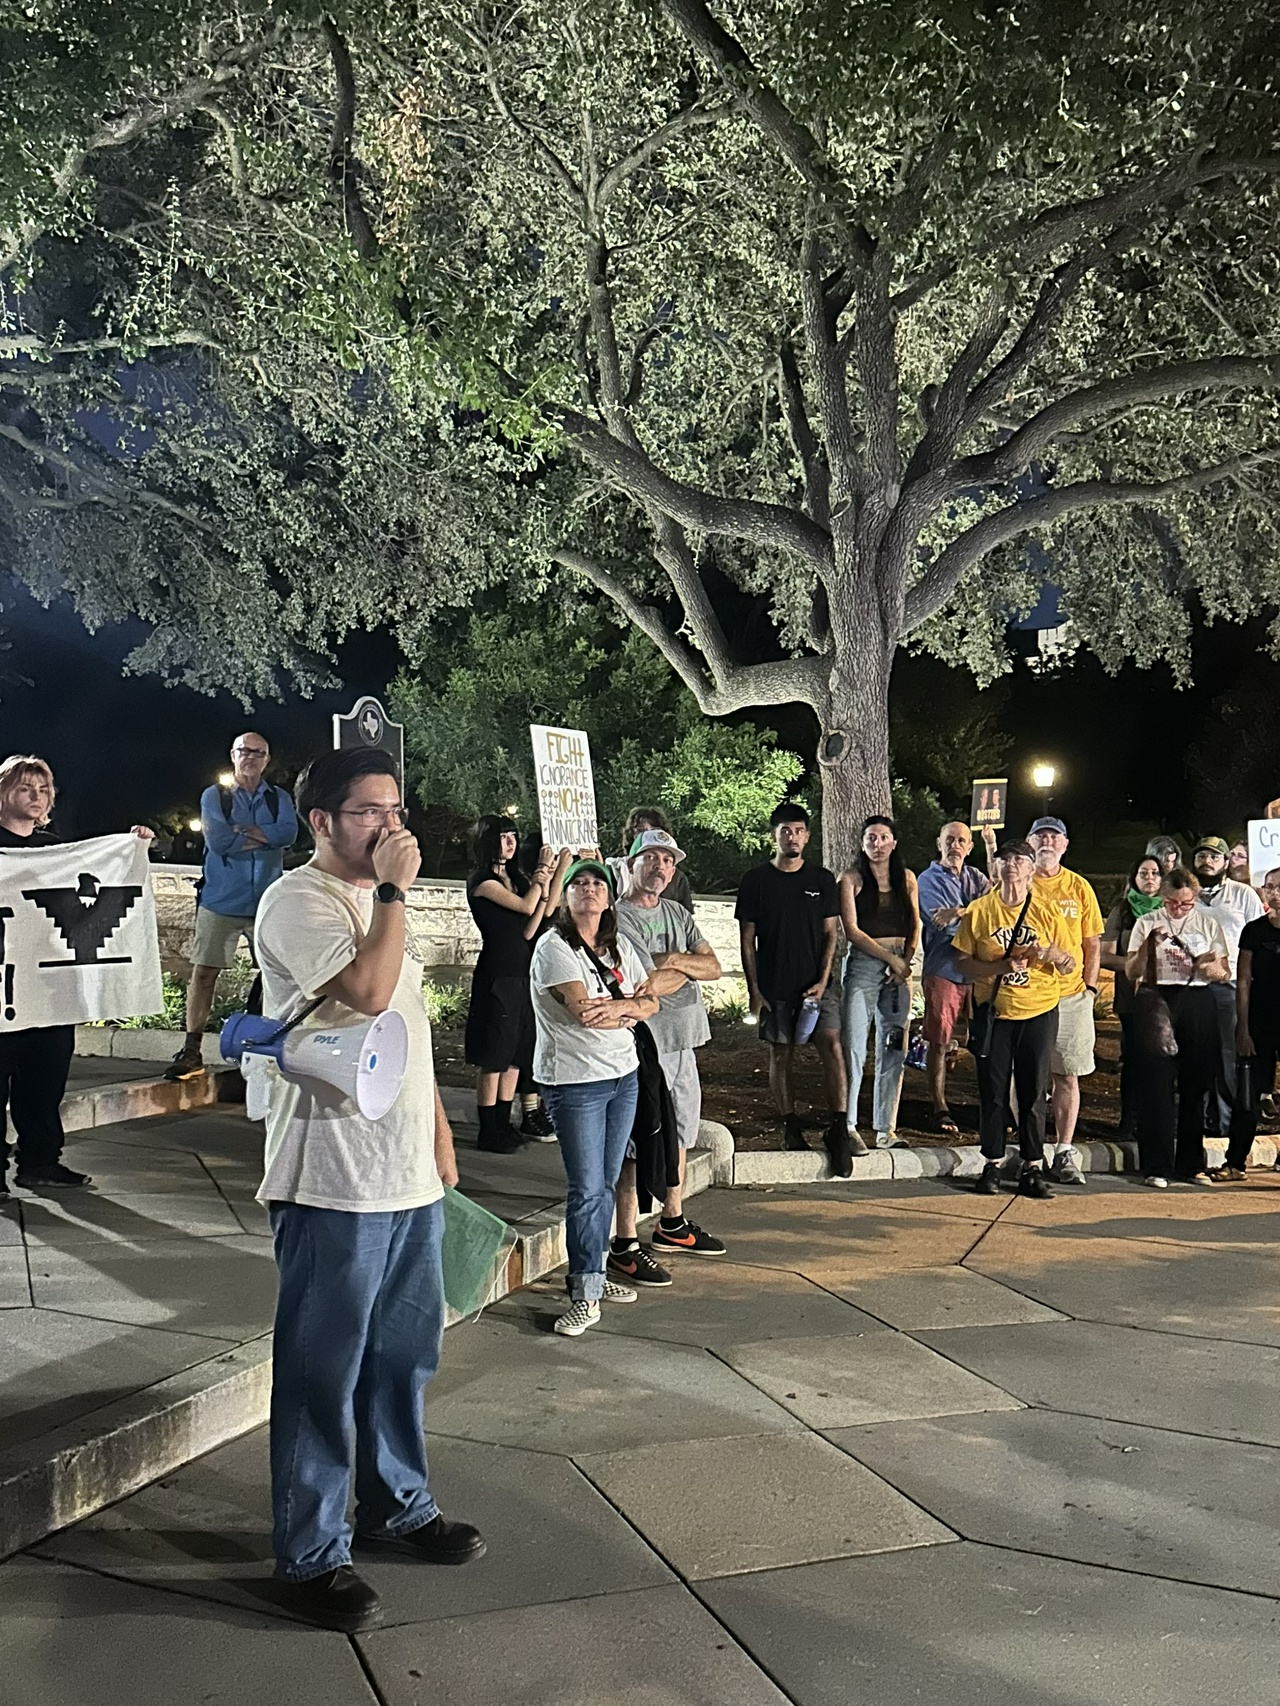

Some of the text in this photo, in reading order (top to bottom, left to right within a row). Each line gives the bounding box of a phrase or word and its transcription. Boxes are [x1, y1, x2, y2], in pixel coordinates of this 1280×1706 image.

[539, 764, 589, 789] IGNORANCE
[1003, 971, 1030, 986] 2025
[313, 1034, 341, 1045] PYLE
